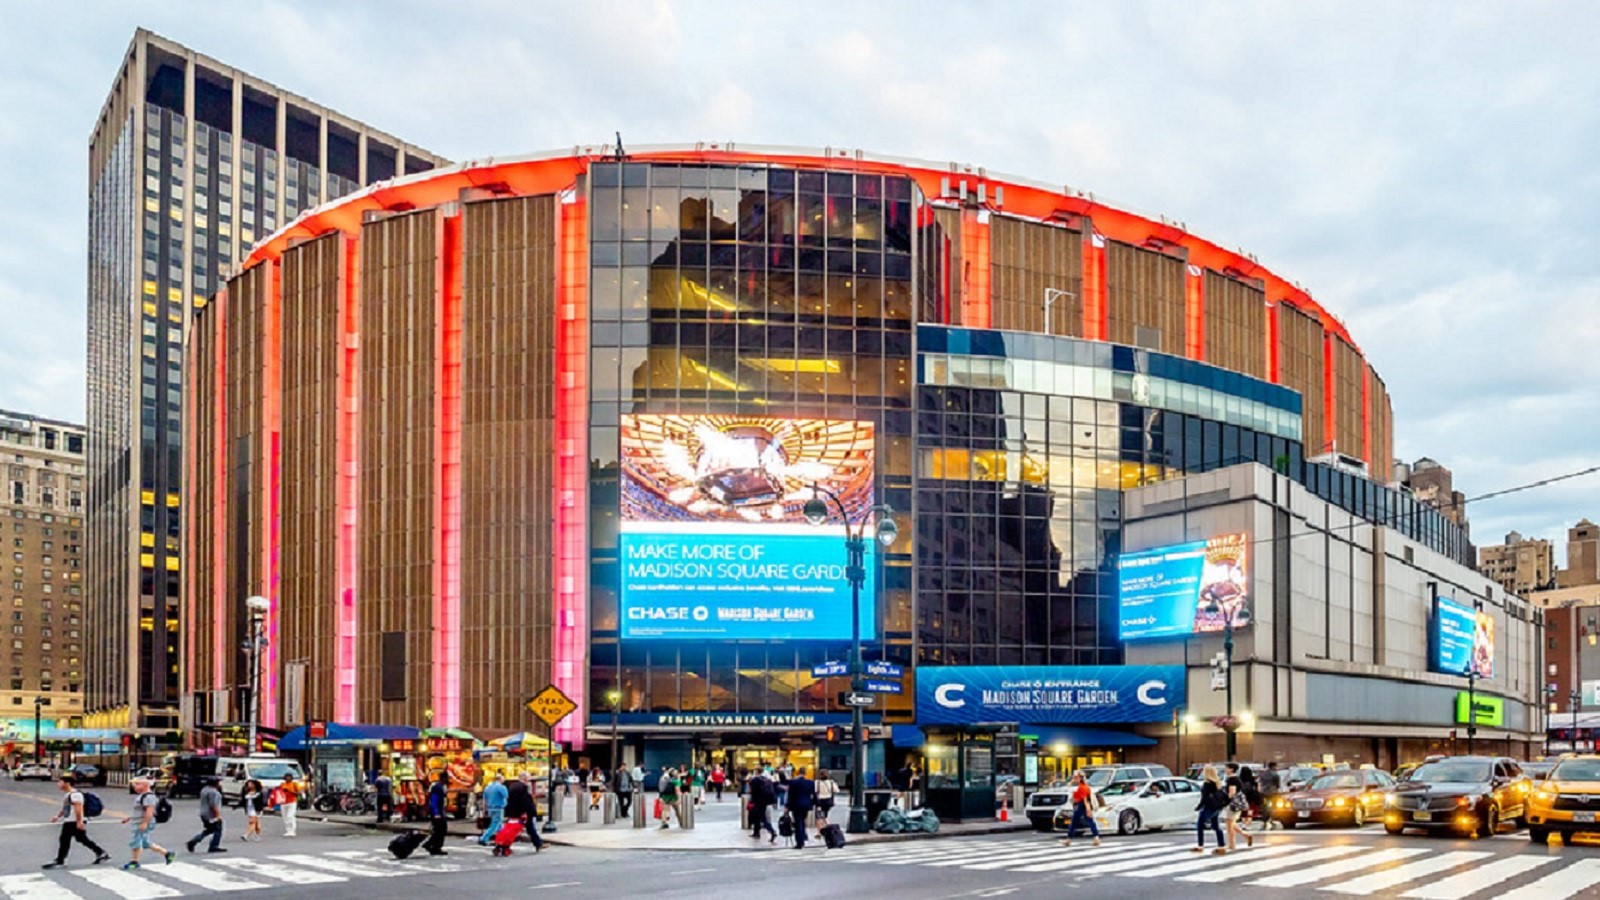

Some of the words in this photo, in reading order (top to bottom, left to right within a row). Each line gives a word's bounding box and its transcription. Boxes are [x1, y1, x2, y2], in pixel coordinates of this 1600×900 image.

[628, 544, 678, 559] MAKE
[682, 544, 736, 560] MORE
[738, 545, 765, 560] OF
[628, 563, 713, 578] MADISON
[717, 563, 789, 581] SQUARE
[792, 564, 847, 580] GARD
[628, 607, 689, 620] CHASE
[1001, 680, 1031, 688] CHASE
[1044, 680, 1100, 688] ENTRANCE
[934, 683, 966, 709] C
[982, 689, 1031, 704] MADISON
[1032, 689, 1074, 704] SQUARE
[1136, 680, 1167, 706] C
[538, 697, 564, 705] DEAD
[542, 707, 561, 715] END
[658, 715, 759, 724] PENNSYLVANIA
[763, 715, 815, 724] STATION
